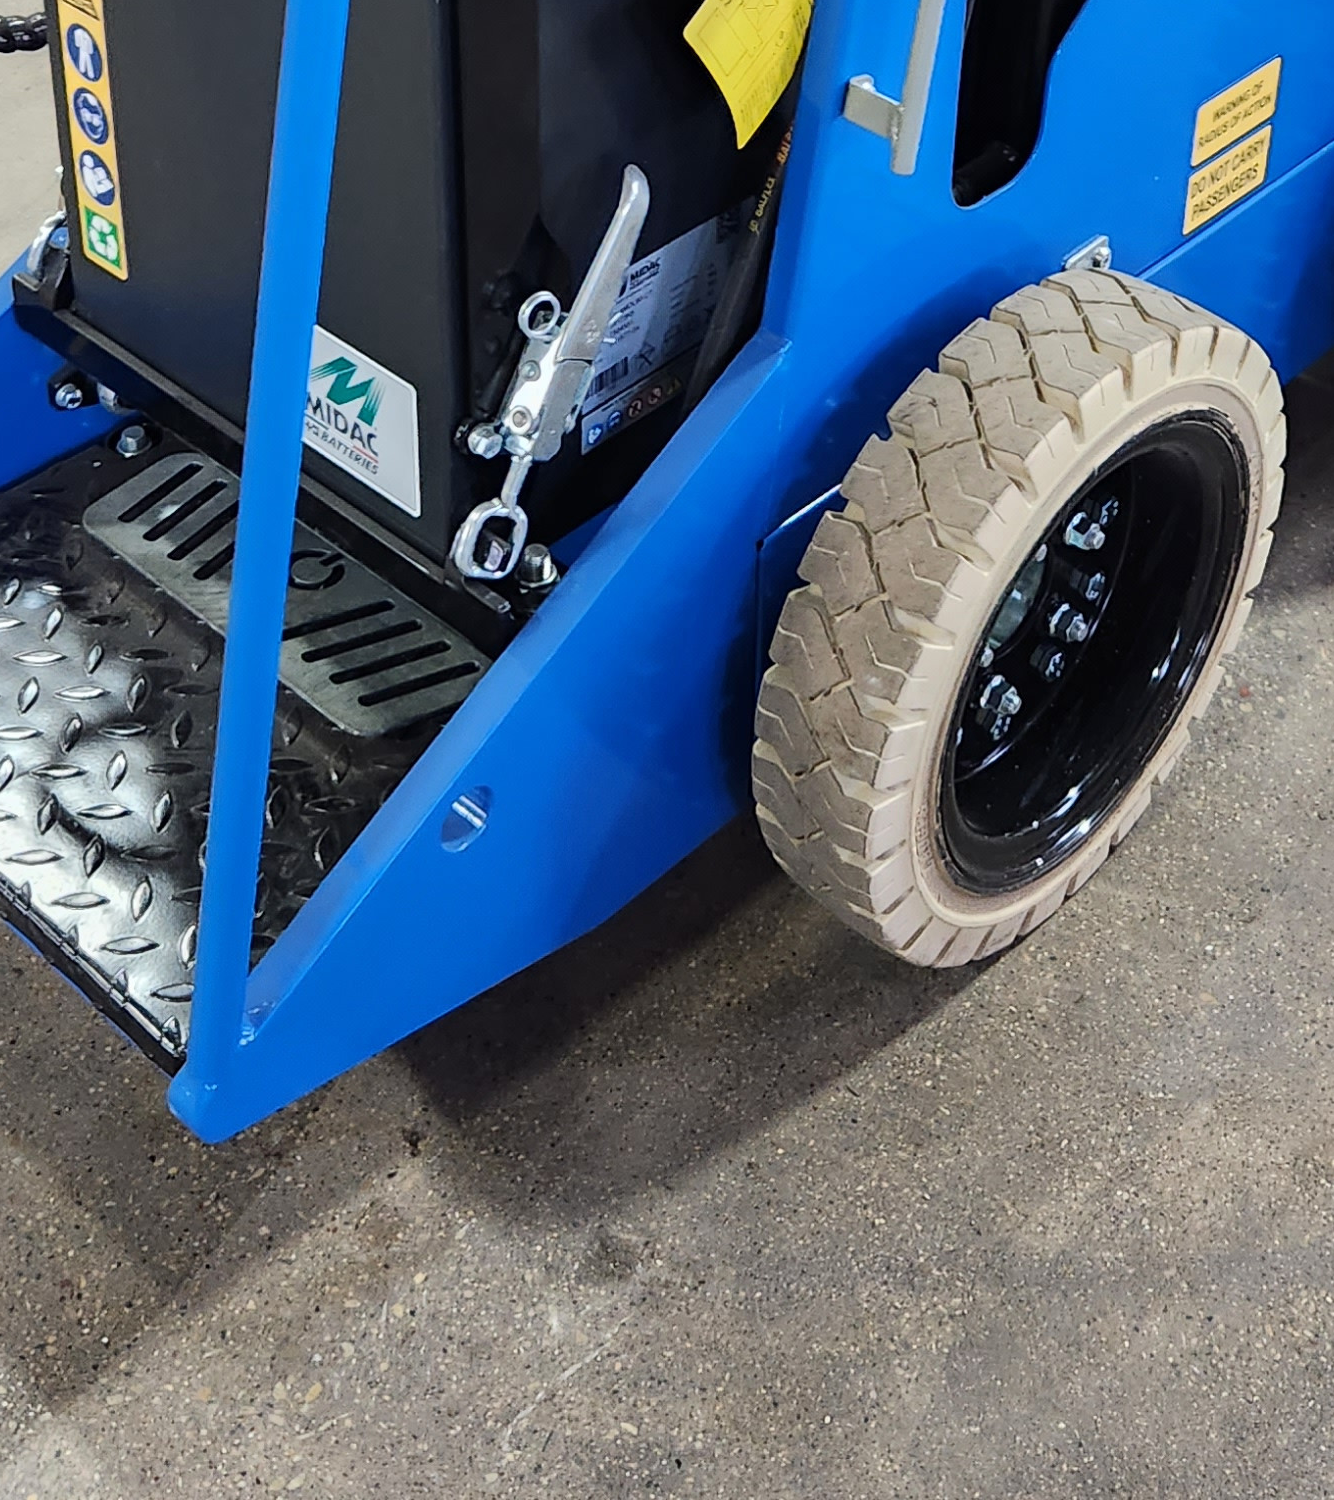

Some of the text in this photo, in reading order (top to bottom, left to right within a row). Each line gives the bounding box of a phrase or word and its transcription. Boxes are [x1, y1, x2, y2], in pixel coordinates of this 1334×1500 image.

[1197, 92, 1272, 150] RADIUS OF ACTION
[1212, 80, 1264, 122] WARNING OF
[1190, 135, 1267, 199] DO NOT CARRY
[1191, 162, 1260, 222] PASSENGERS
[307, 391, 380, 458] MIDAC
[321, 431, 380, 476] BATTERIES
